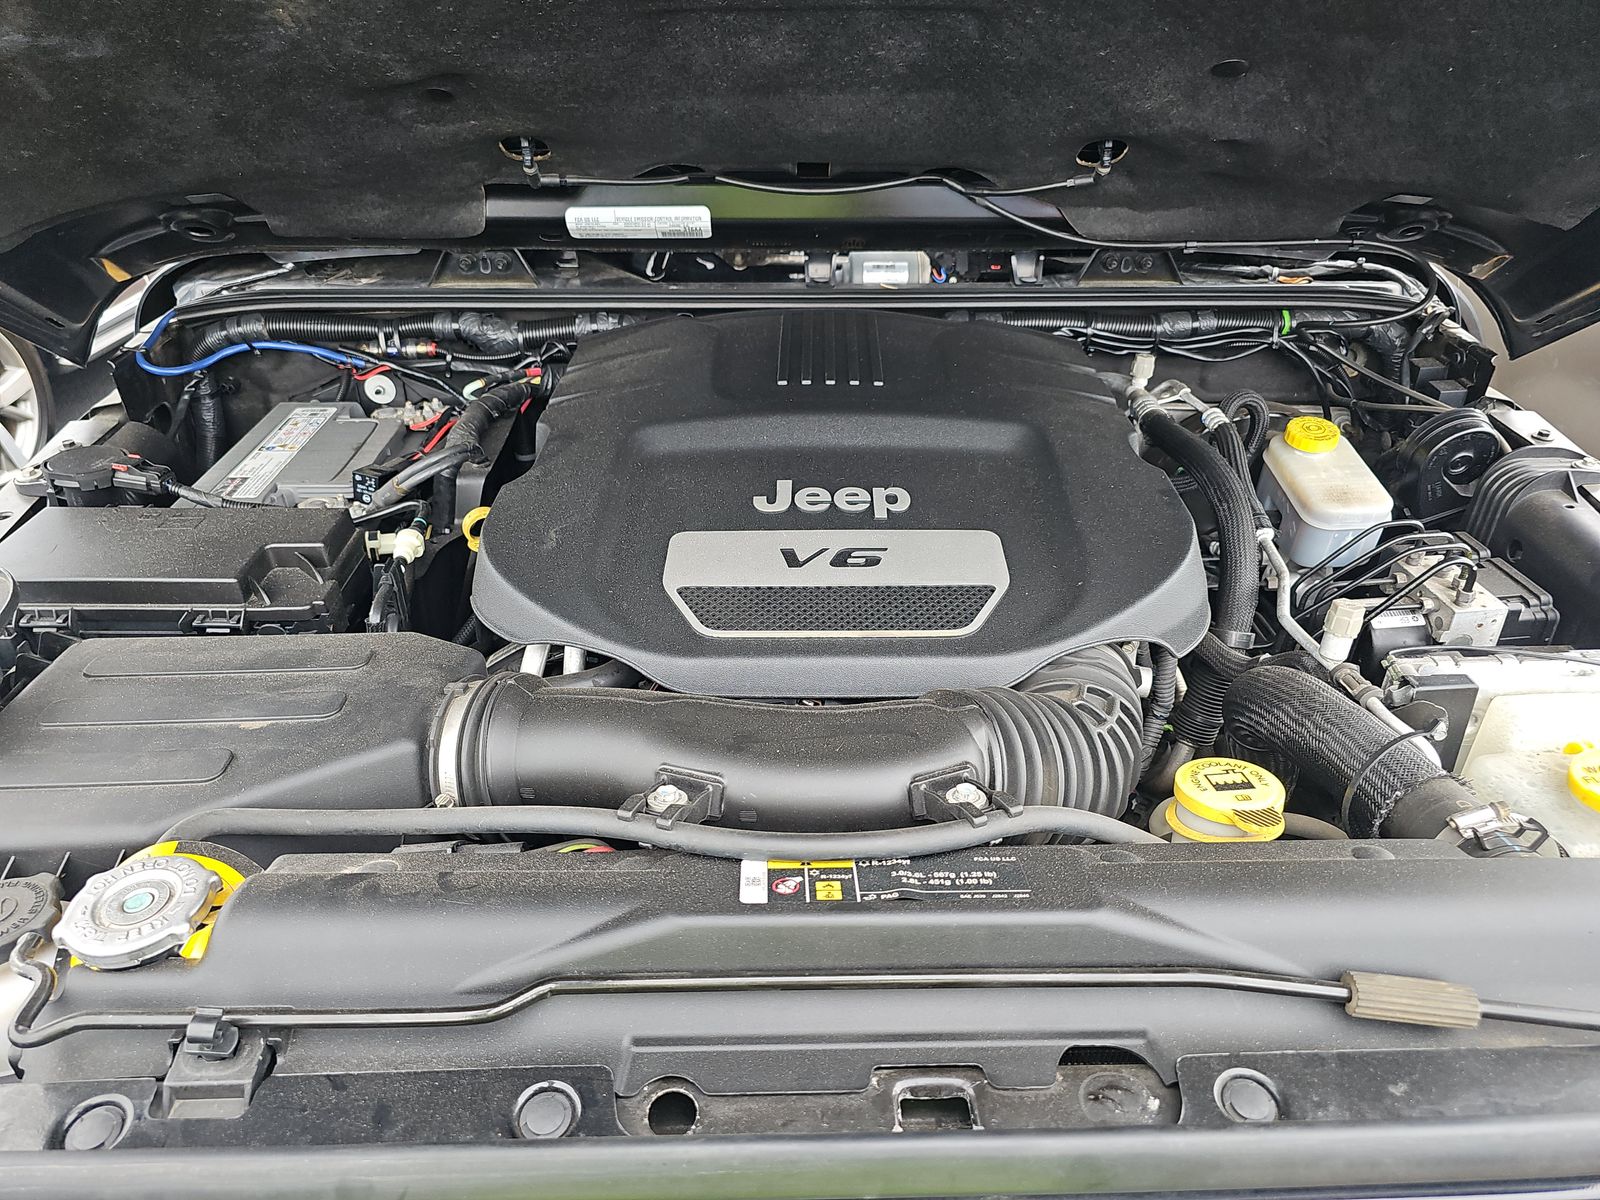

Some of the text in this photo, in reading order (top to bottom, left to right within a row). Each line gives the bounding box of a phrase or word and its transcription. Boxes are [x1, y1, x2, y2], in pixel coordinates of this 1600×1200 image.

[752, 479, 911, 520] Jeep
[779, 547, 889, 569] V6
[1191, 761, 1270, 792] ENGINE COOLANT ONLY
